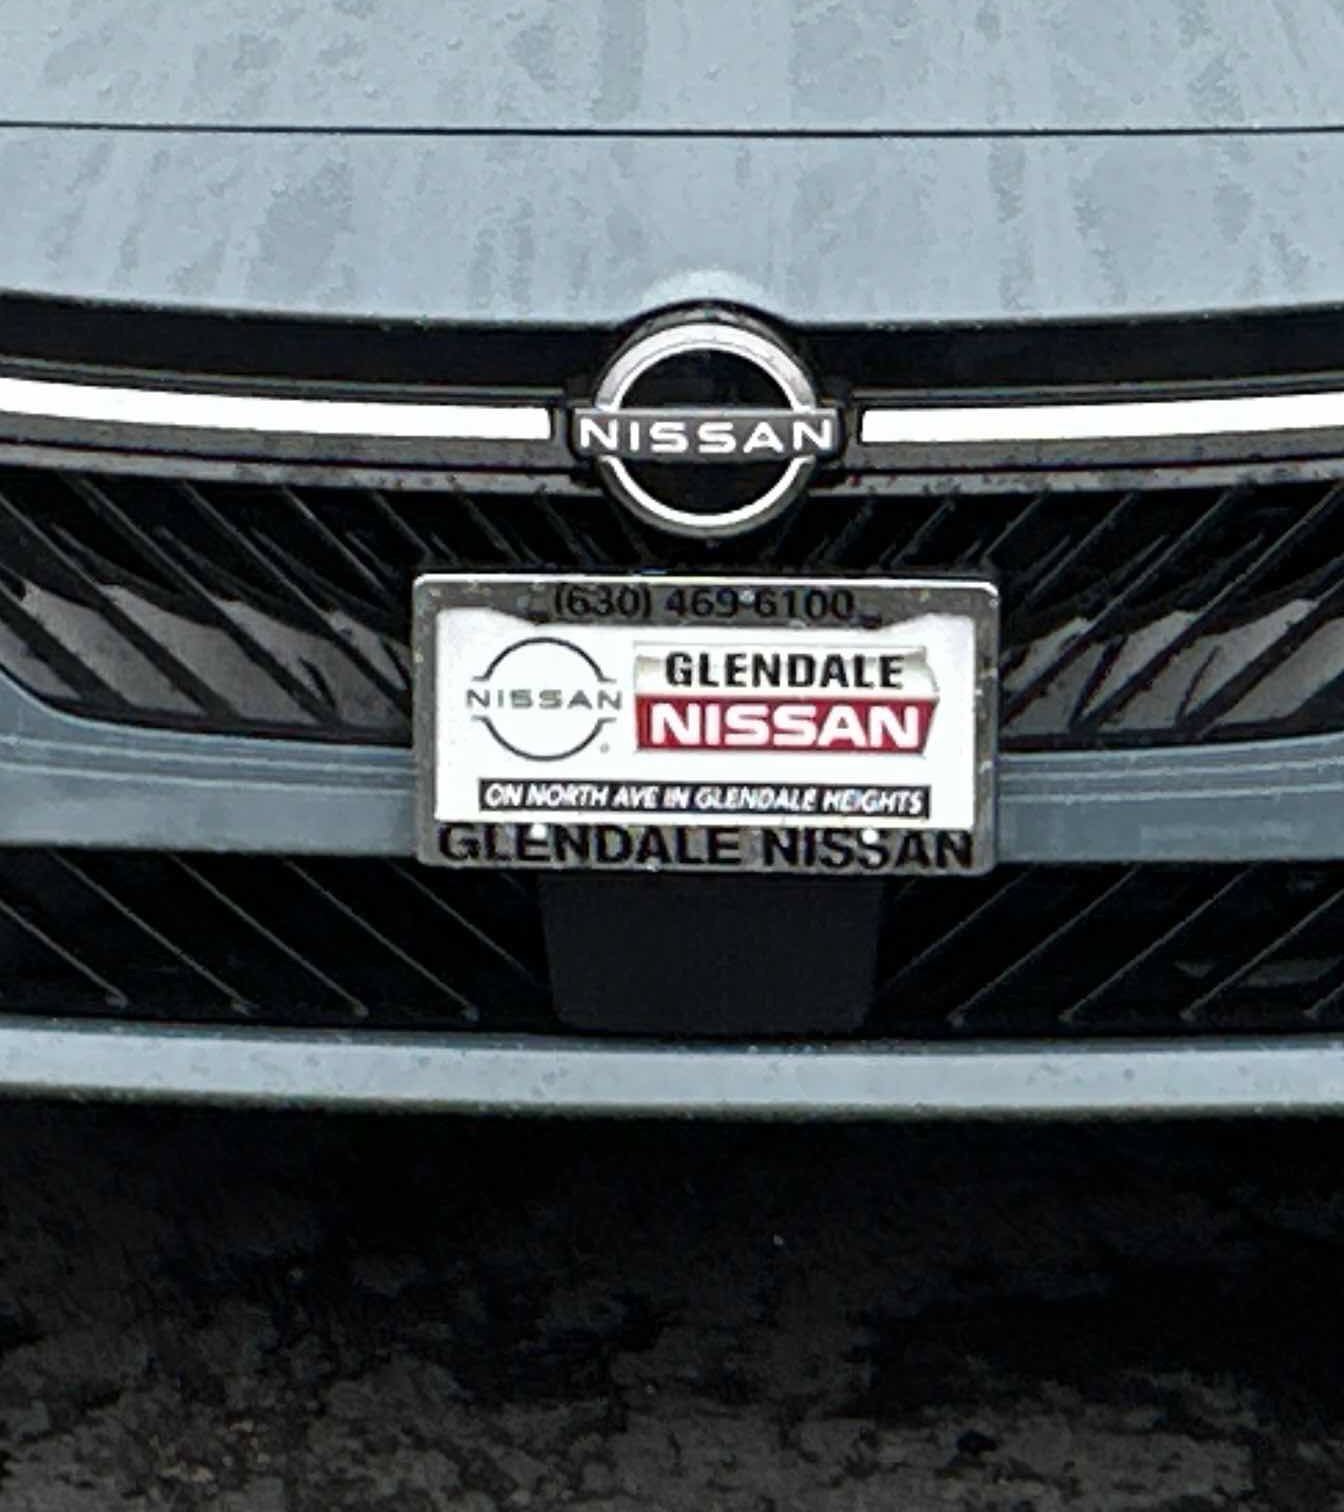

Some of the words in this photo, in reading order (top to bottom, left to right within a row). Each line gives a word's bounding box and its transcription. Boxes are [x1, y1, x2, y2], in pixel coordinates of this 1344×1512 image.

[581, 419, 832, 453] NISSAN
[556, 583, 652, 620] (630)
[665, 651, 904, 689] GLENDALE
[466, 687, 623, 710] NISSAN
[650, 702, 919, 749] NISSAN
[485, 783, 523, 807] ON
[525, 783, 608, 808] NORTH
[611, 784, 658, 809] AVE
[662, 785, 695, 809] IN
[694, 786, 816, 811] GLENDALE
[438, 823, 742, 866] GLENDALE
[762, 826, 975, 870] NISSAN
